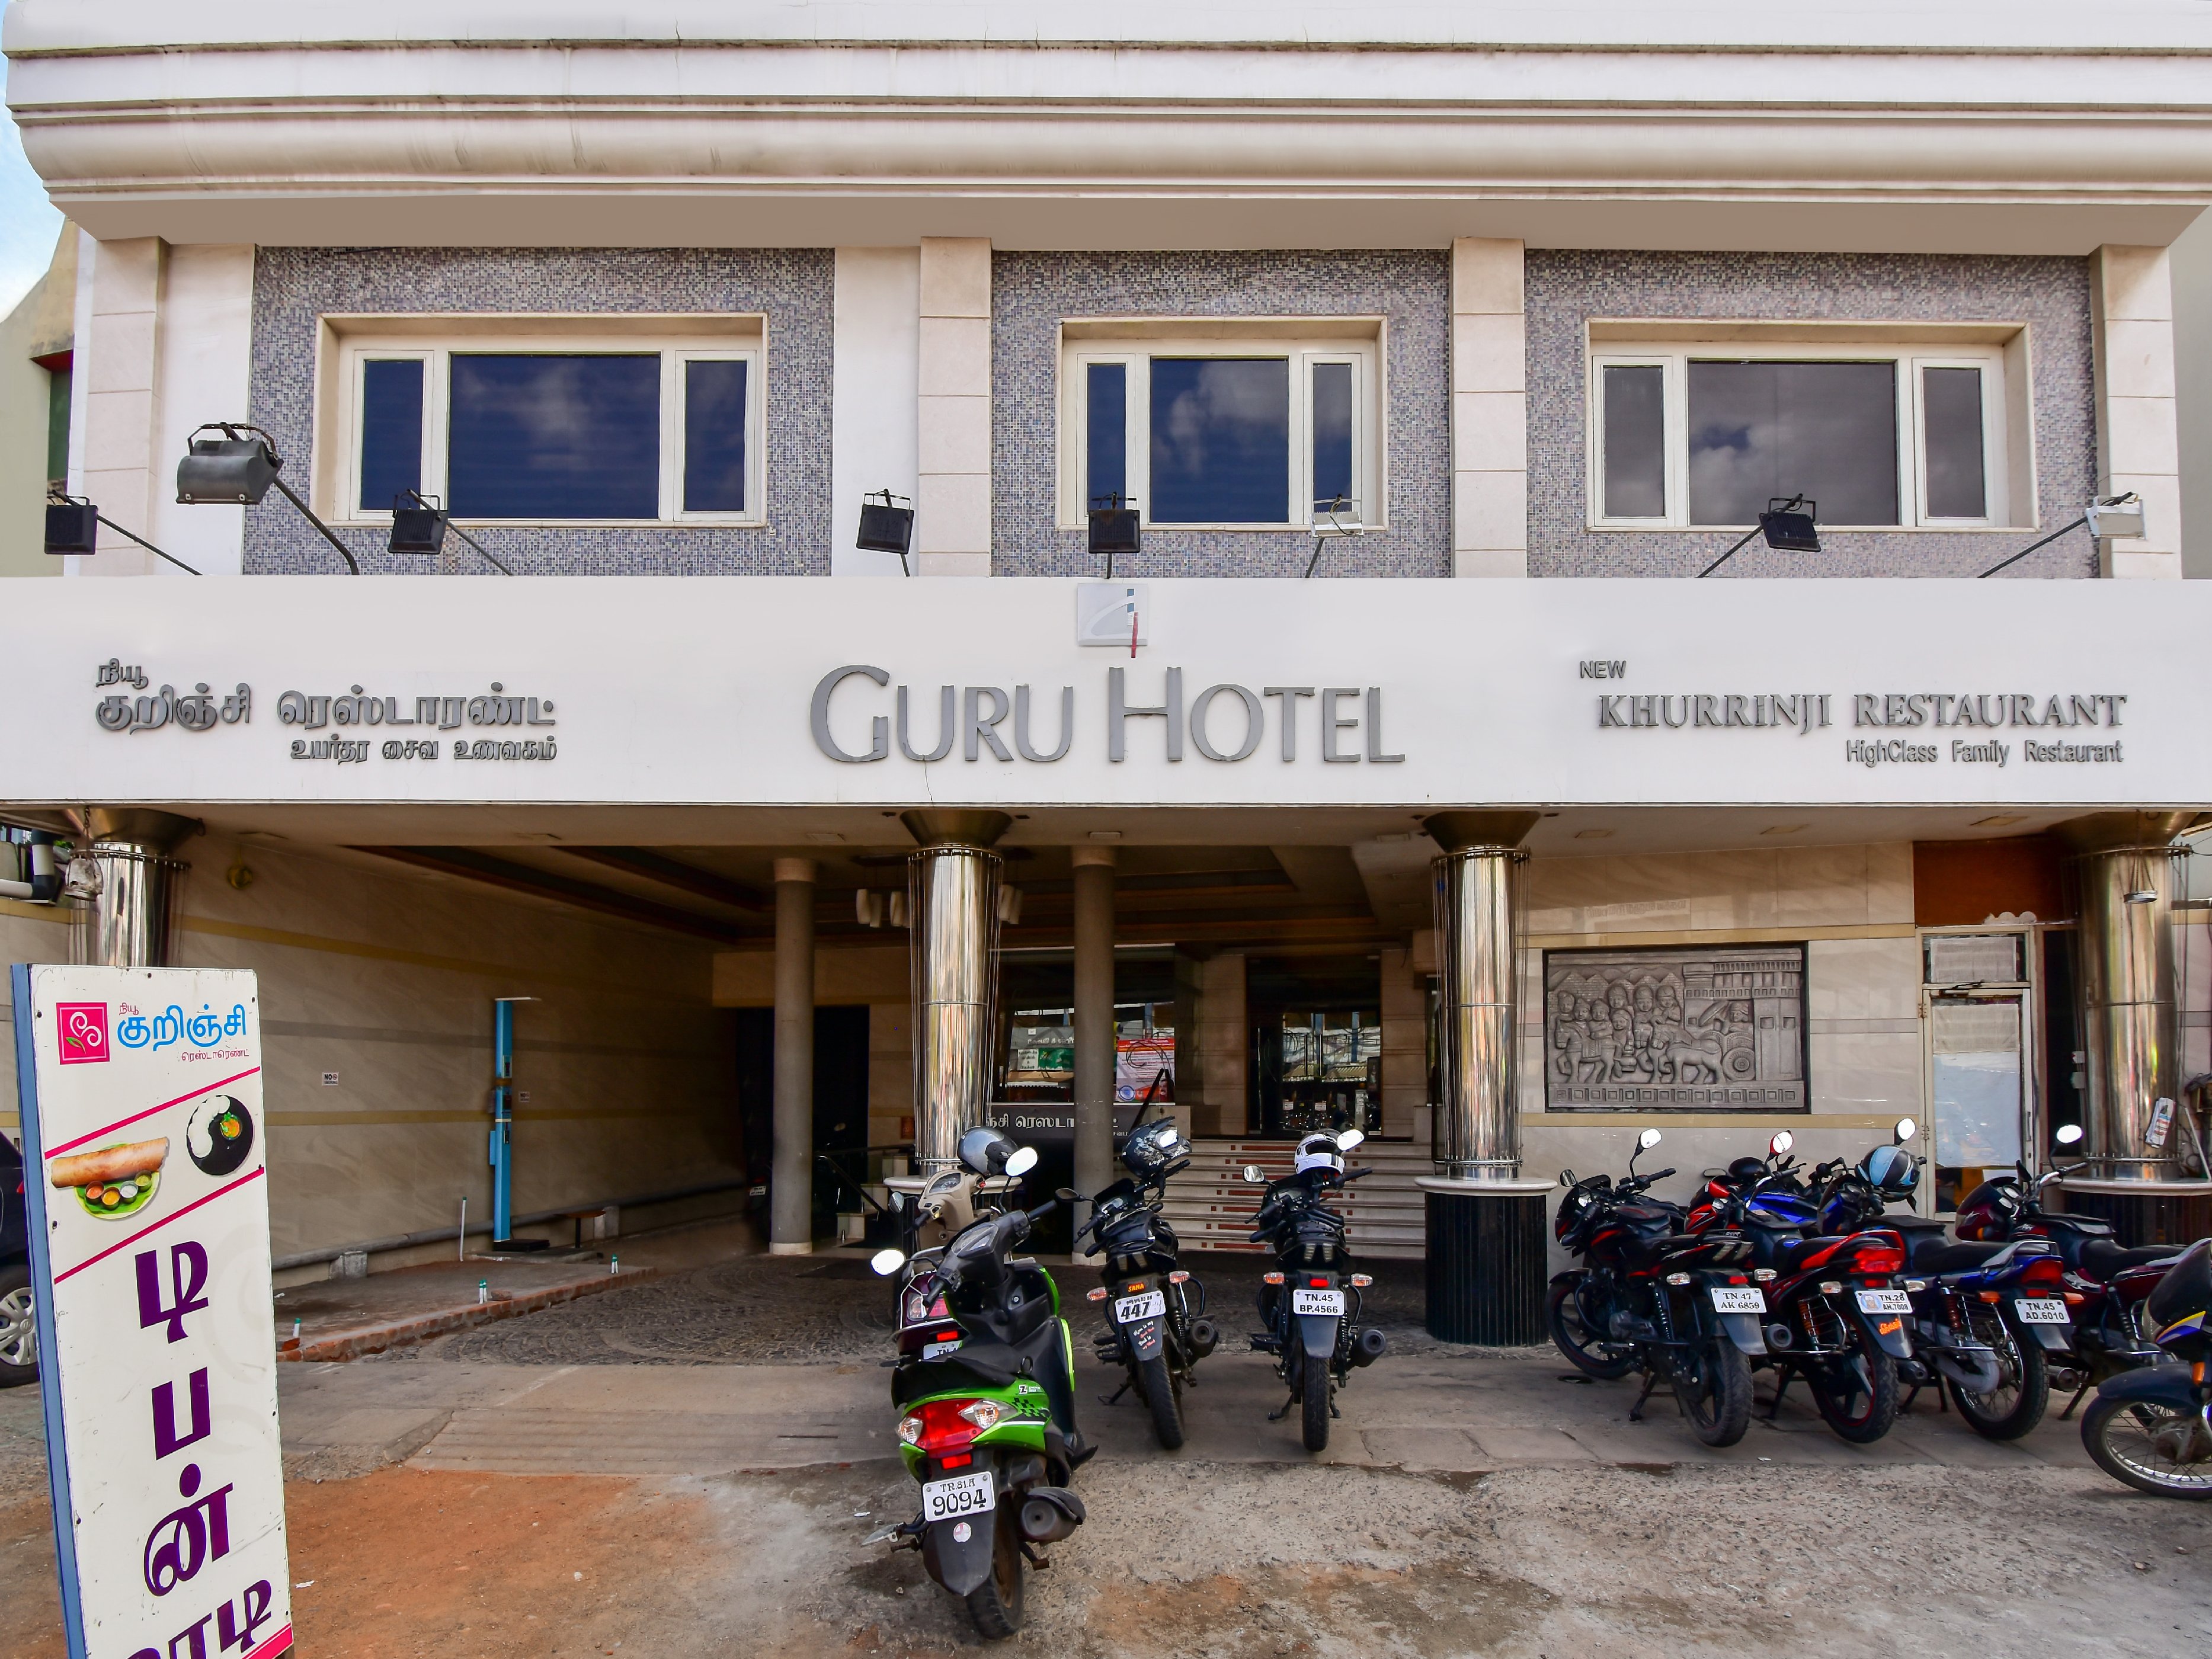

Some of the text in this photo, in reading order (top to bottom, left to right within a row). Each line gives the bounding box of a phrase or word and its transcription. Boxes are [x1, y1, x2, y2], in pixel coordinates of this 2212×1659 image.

[96, 658, 148, 689] நியூ
[1580, 661, 1627, 678] NEW
[95, 682, 556, 735] குறிஞ்சி ரெஸ்டாரண்ட்
[810, 665, 1406, 763] GURU HOTEL
[1599, 693, 2128, 735] KHURRINJI RESTAURANT
[290, 734, 557, 765] உயர்தர சைவ உணவகம்
[1846, 739, 2124, 767] HighClass Family Restaurant
[119, 1003, 139, 1015] நியூ
[117, 1004, 246, 1051] குறிஞ்சி
[1300, 1305, 1338, 1313] BP.4566
[933, 1488, 987, 1516] 9094
